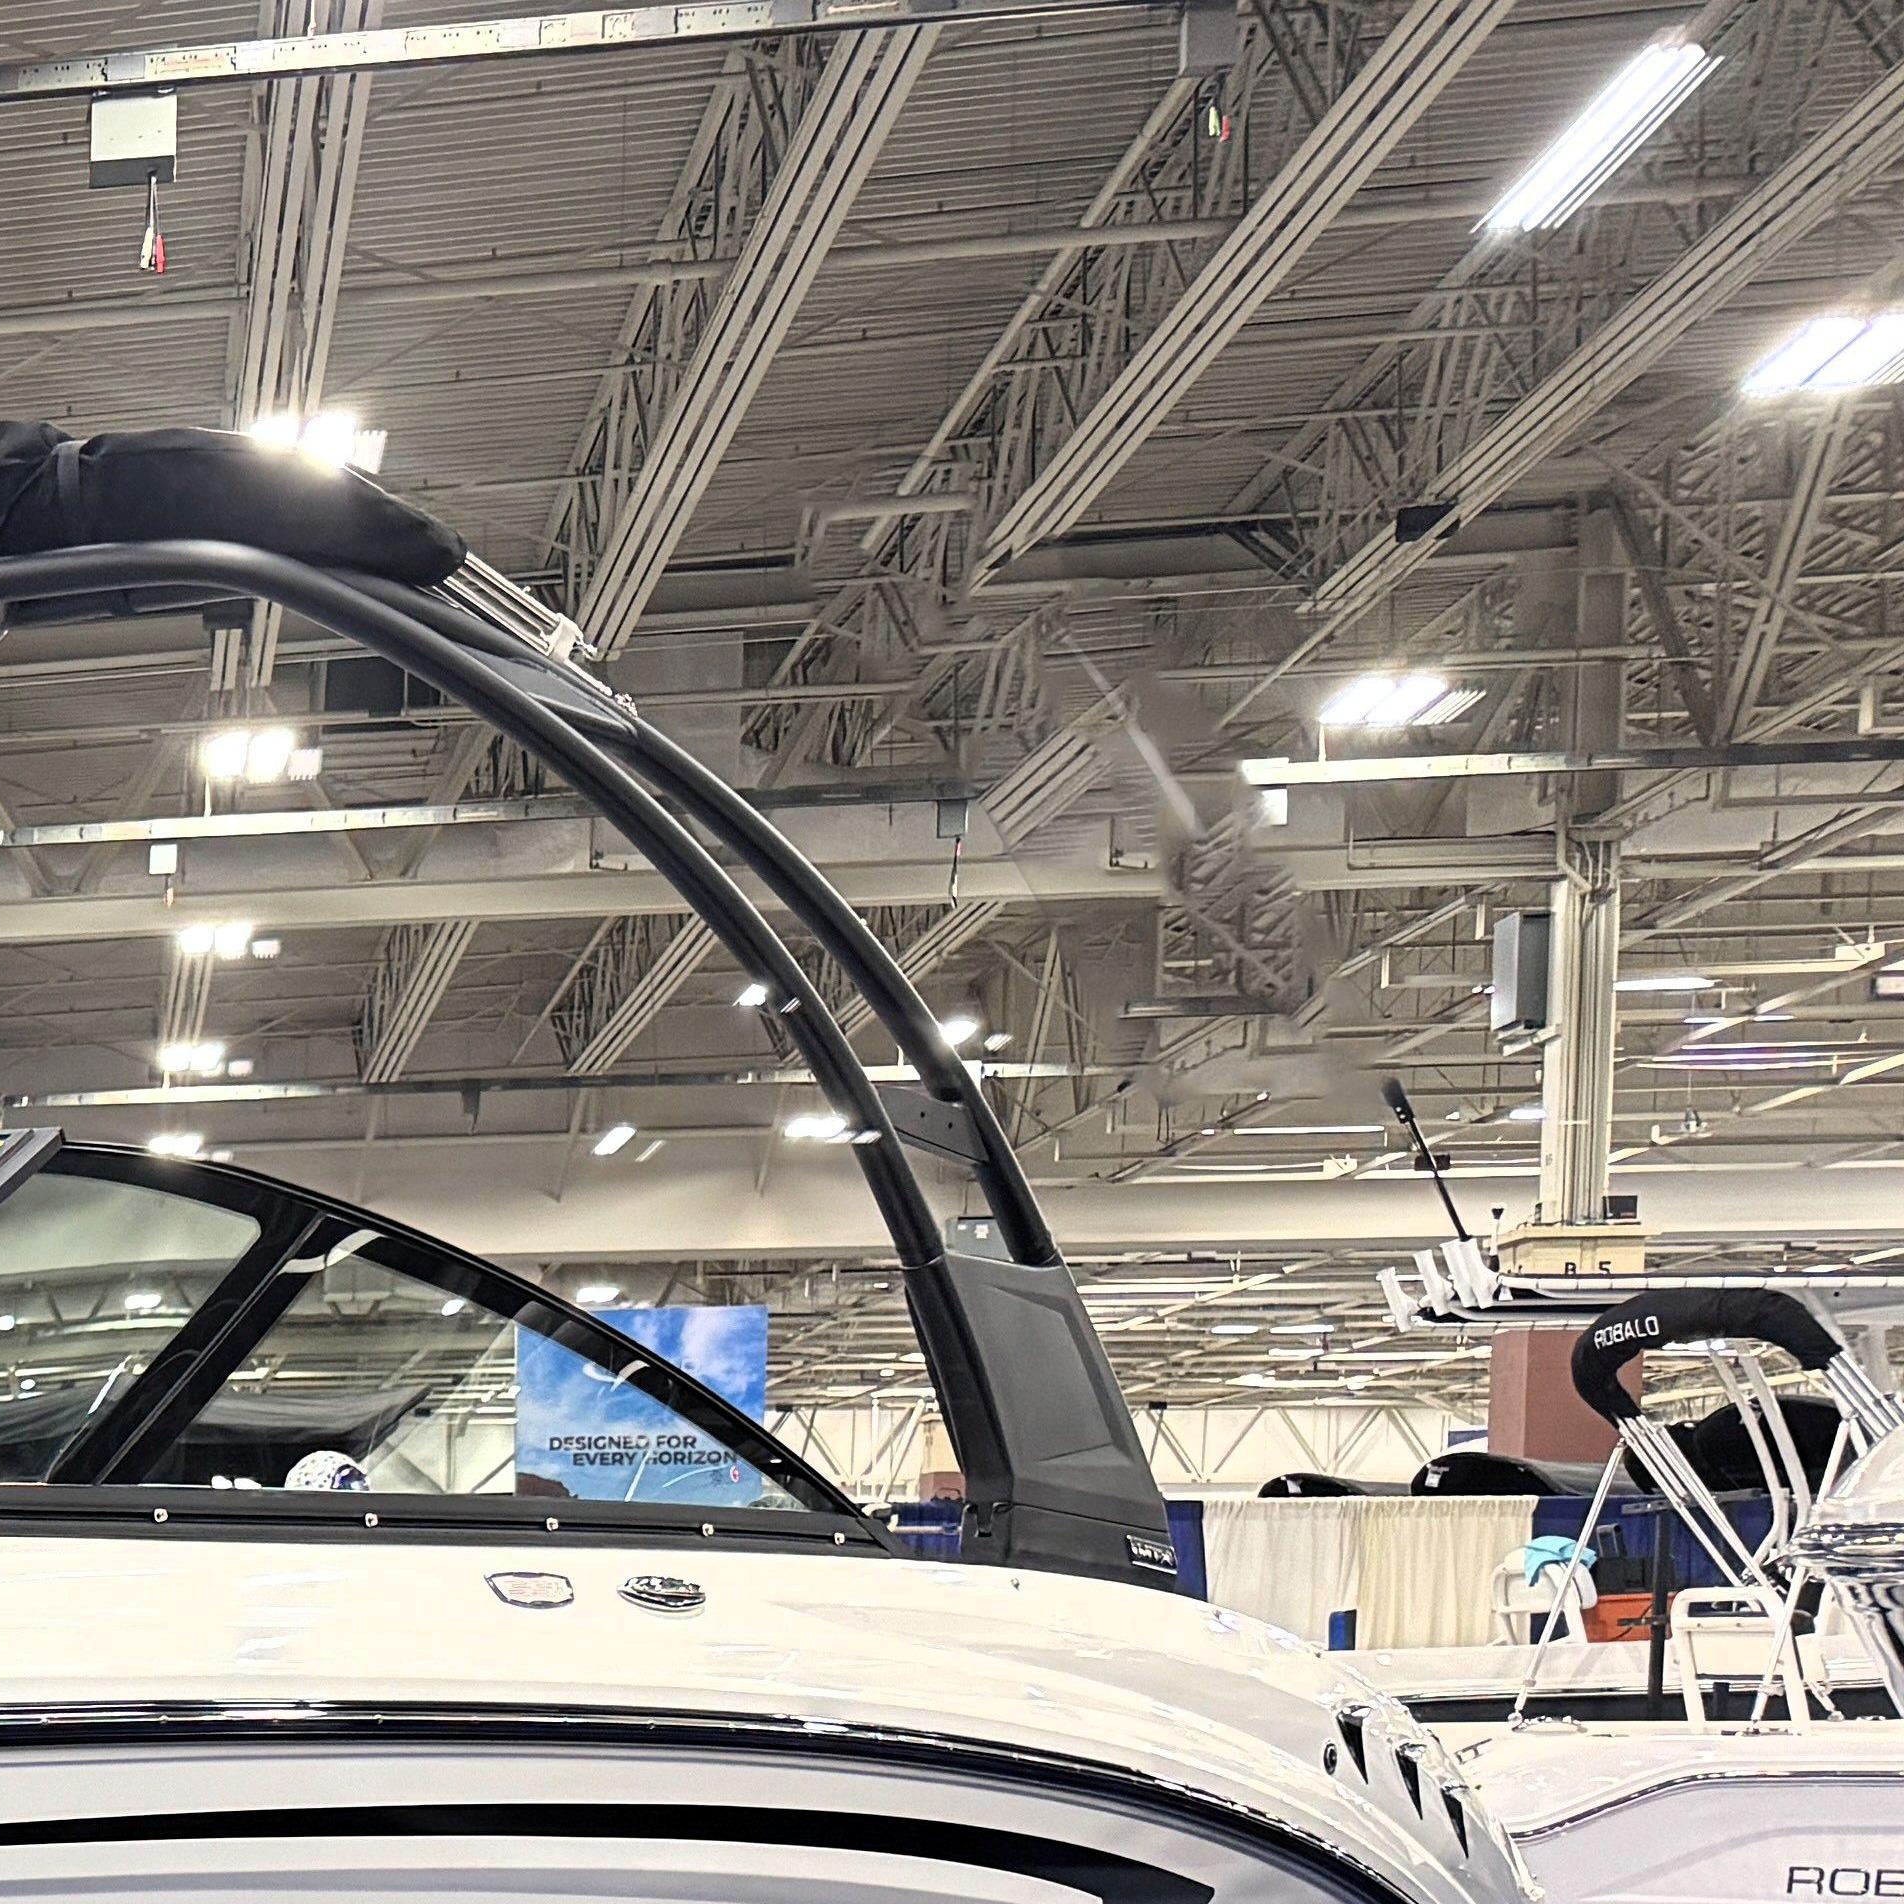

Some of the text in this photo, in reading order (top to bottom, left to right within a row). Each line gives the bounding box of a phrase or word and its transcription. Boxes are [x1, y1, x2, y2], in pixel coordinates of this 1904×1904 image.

[1593, 1315, 1660, 1350] ROBALO
[548, 1434, 697, 1451] DESIGNED FOR
[572, 1452, 636, 1466] EVERY
